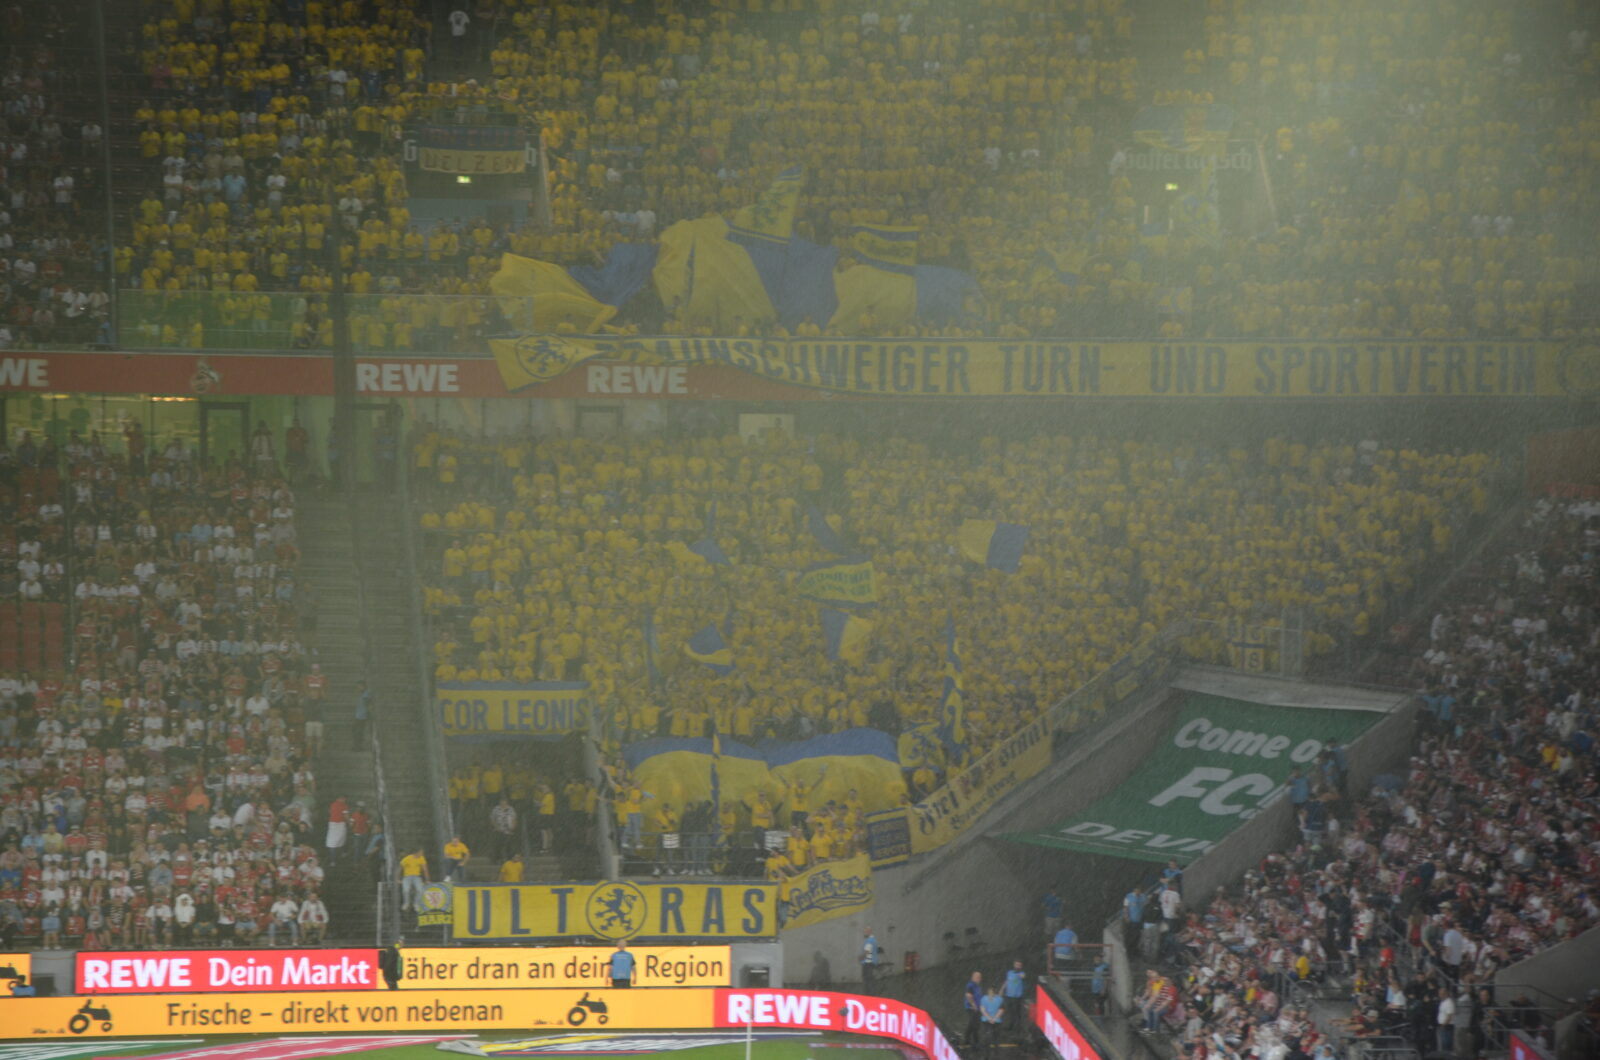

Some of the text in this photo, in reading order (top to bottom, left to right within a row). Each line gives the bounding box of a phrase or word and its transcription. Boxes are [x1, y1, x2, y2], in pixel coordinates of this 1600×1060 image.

[355, 362, 461, 393] REWE
[586, 365, 689, 394] REWE
[998, 345, 1116, 397] TURN-
[1148, 345, 1227, 397] UND
[1253, 343, 1536, 397] SPORTVEREIN
[441, 698, 588, 730] COR LEONIS
[1174, 716, 1323, 764] Come o
[83, 957, 371, 989] REWE Dein Markt
[404, 956, 459, 980] äher
[467, 955, 523, 980] dran
[528, 961, 554, 979] an
[645, 952, 724, 985] Region
[167, 1002, 252, 1028] Frische
[281, 1001, 349, 1026] direkt
[357, 1004, 398, 1024] von
[406, 998, 504, 1022] nebenan
[727, 993, 832, 1027] REWE
[845, 998, 901, 1035] Dein
